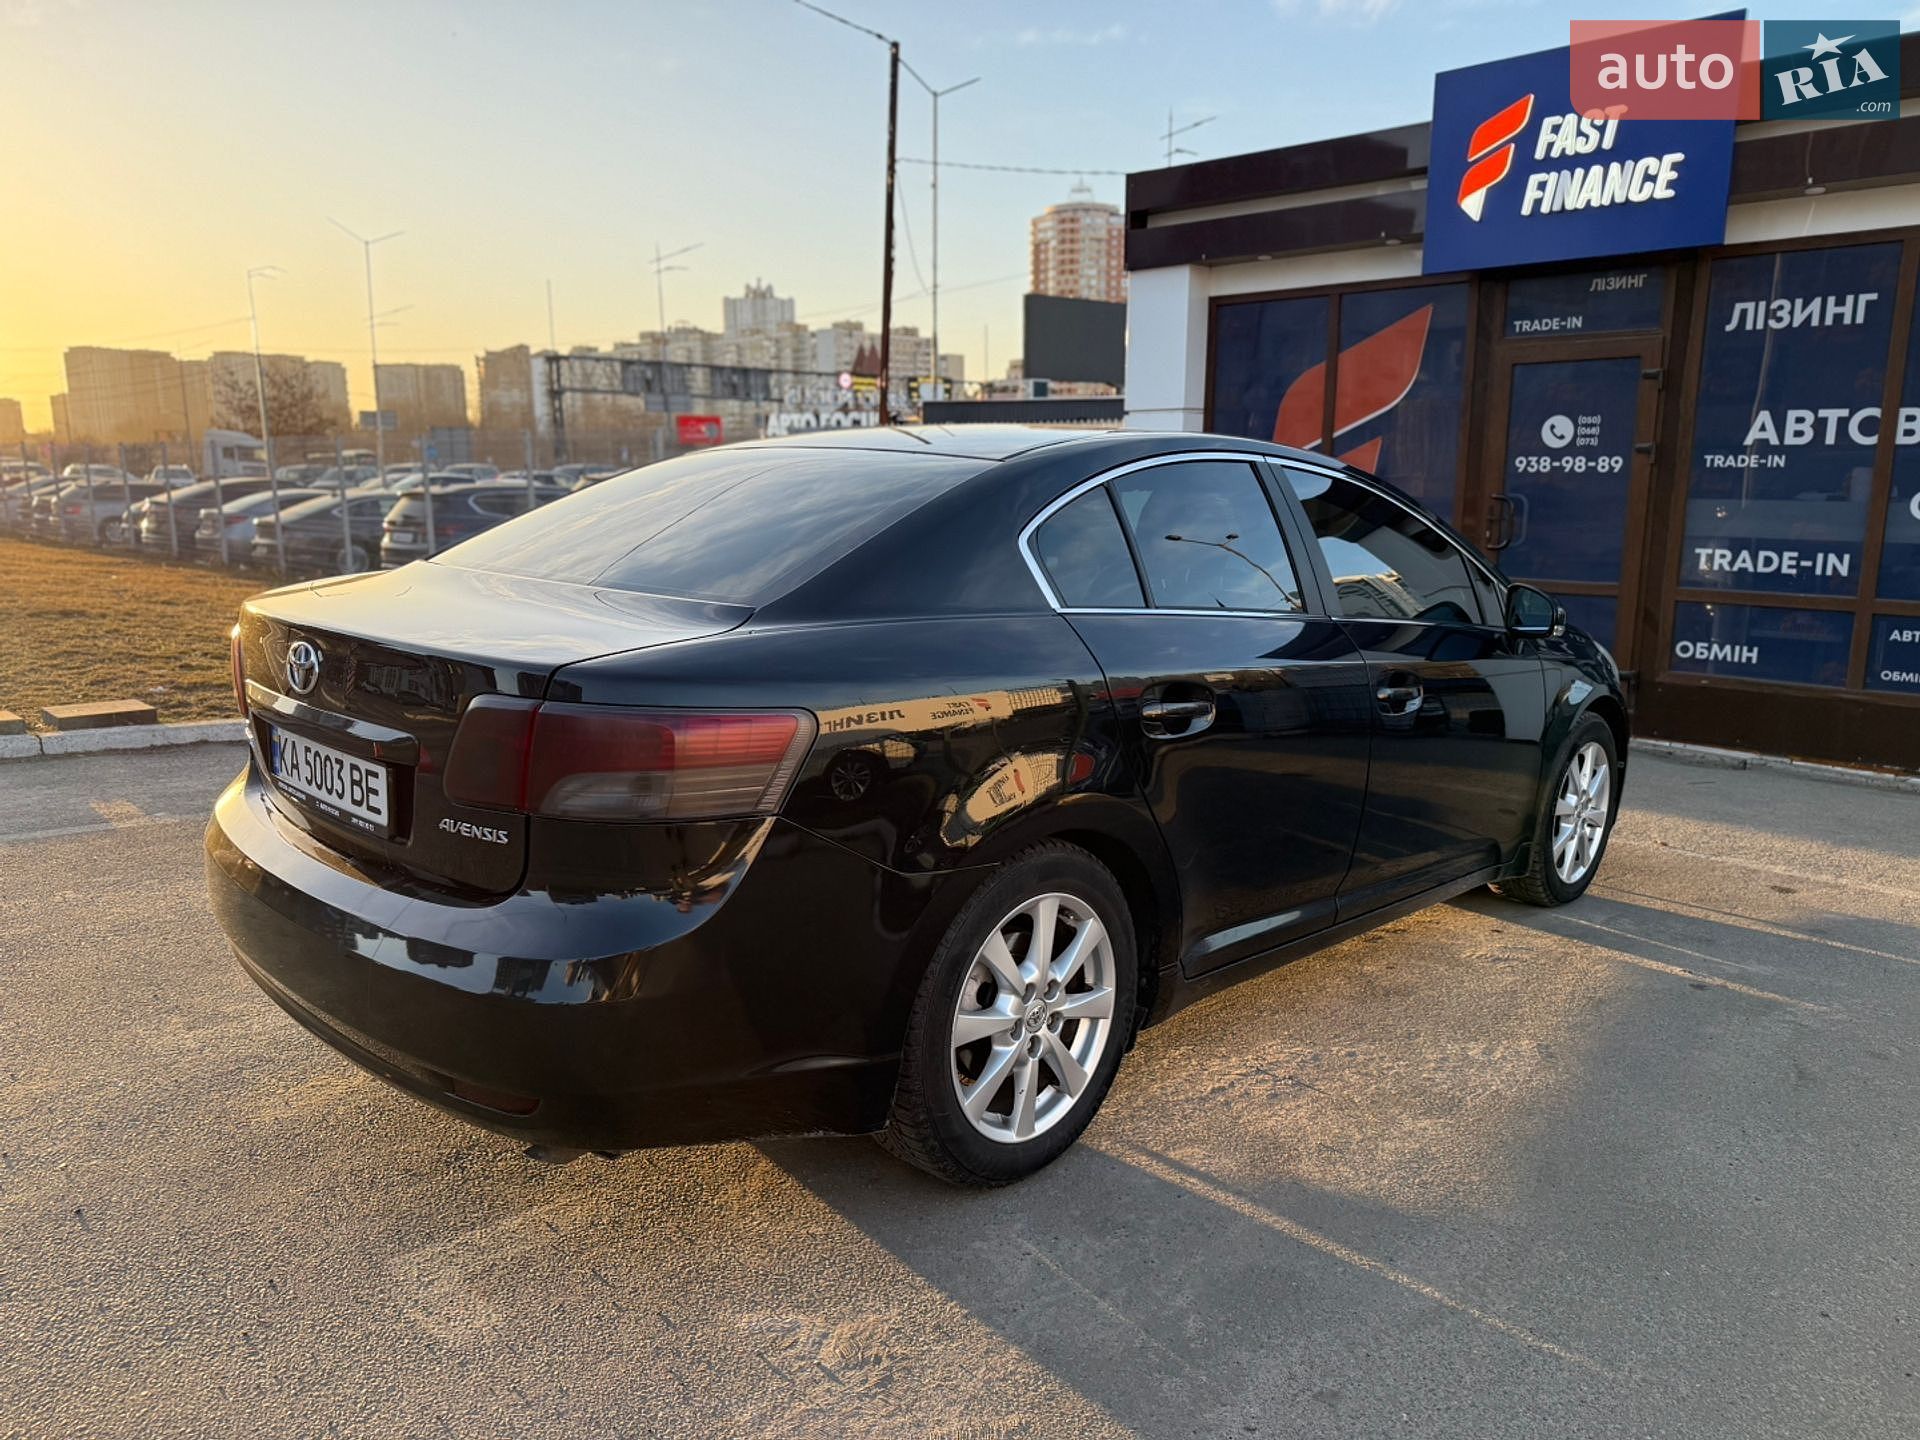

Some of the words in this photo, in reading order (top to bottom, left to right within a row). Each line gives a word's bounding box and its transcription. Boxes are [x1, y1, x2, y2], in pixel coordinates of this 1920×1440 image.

[1534, 105, 1628, 160] FAST
[1521, 153, 1684, 216] FINANCE
[1590, 274, 1647, 292] ЛІЗИНГ
[1514, 316, 1582, 333] TRADE-IN
[1725, 293, 1878, 332] ЛІЗИНГ
[1515, 456, 1623, 473] 938-98-89
[1704, 454, 1786, 468] TRADE-IN
[1695, 548, 1850, 577] TRADE-IN
[1675, 640, 1758, 664] ОБМІН
[279, 735, 300, 782] KA
[304, 745, 346, 800] 5003
[350, 762, 382, 816] BE
[438, 818, 509, 845] AVENSIS
